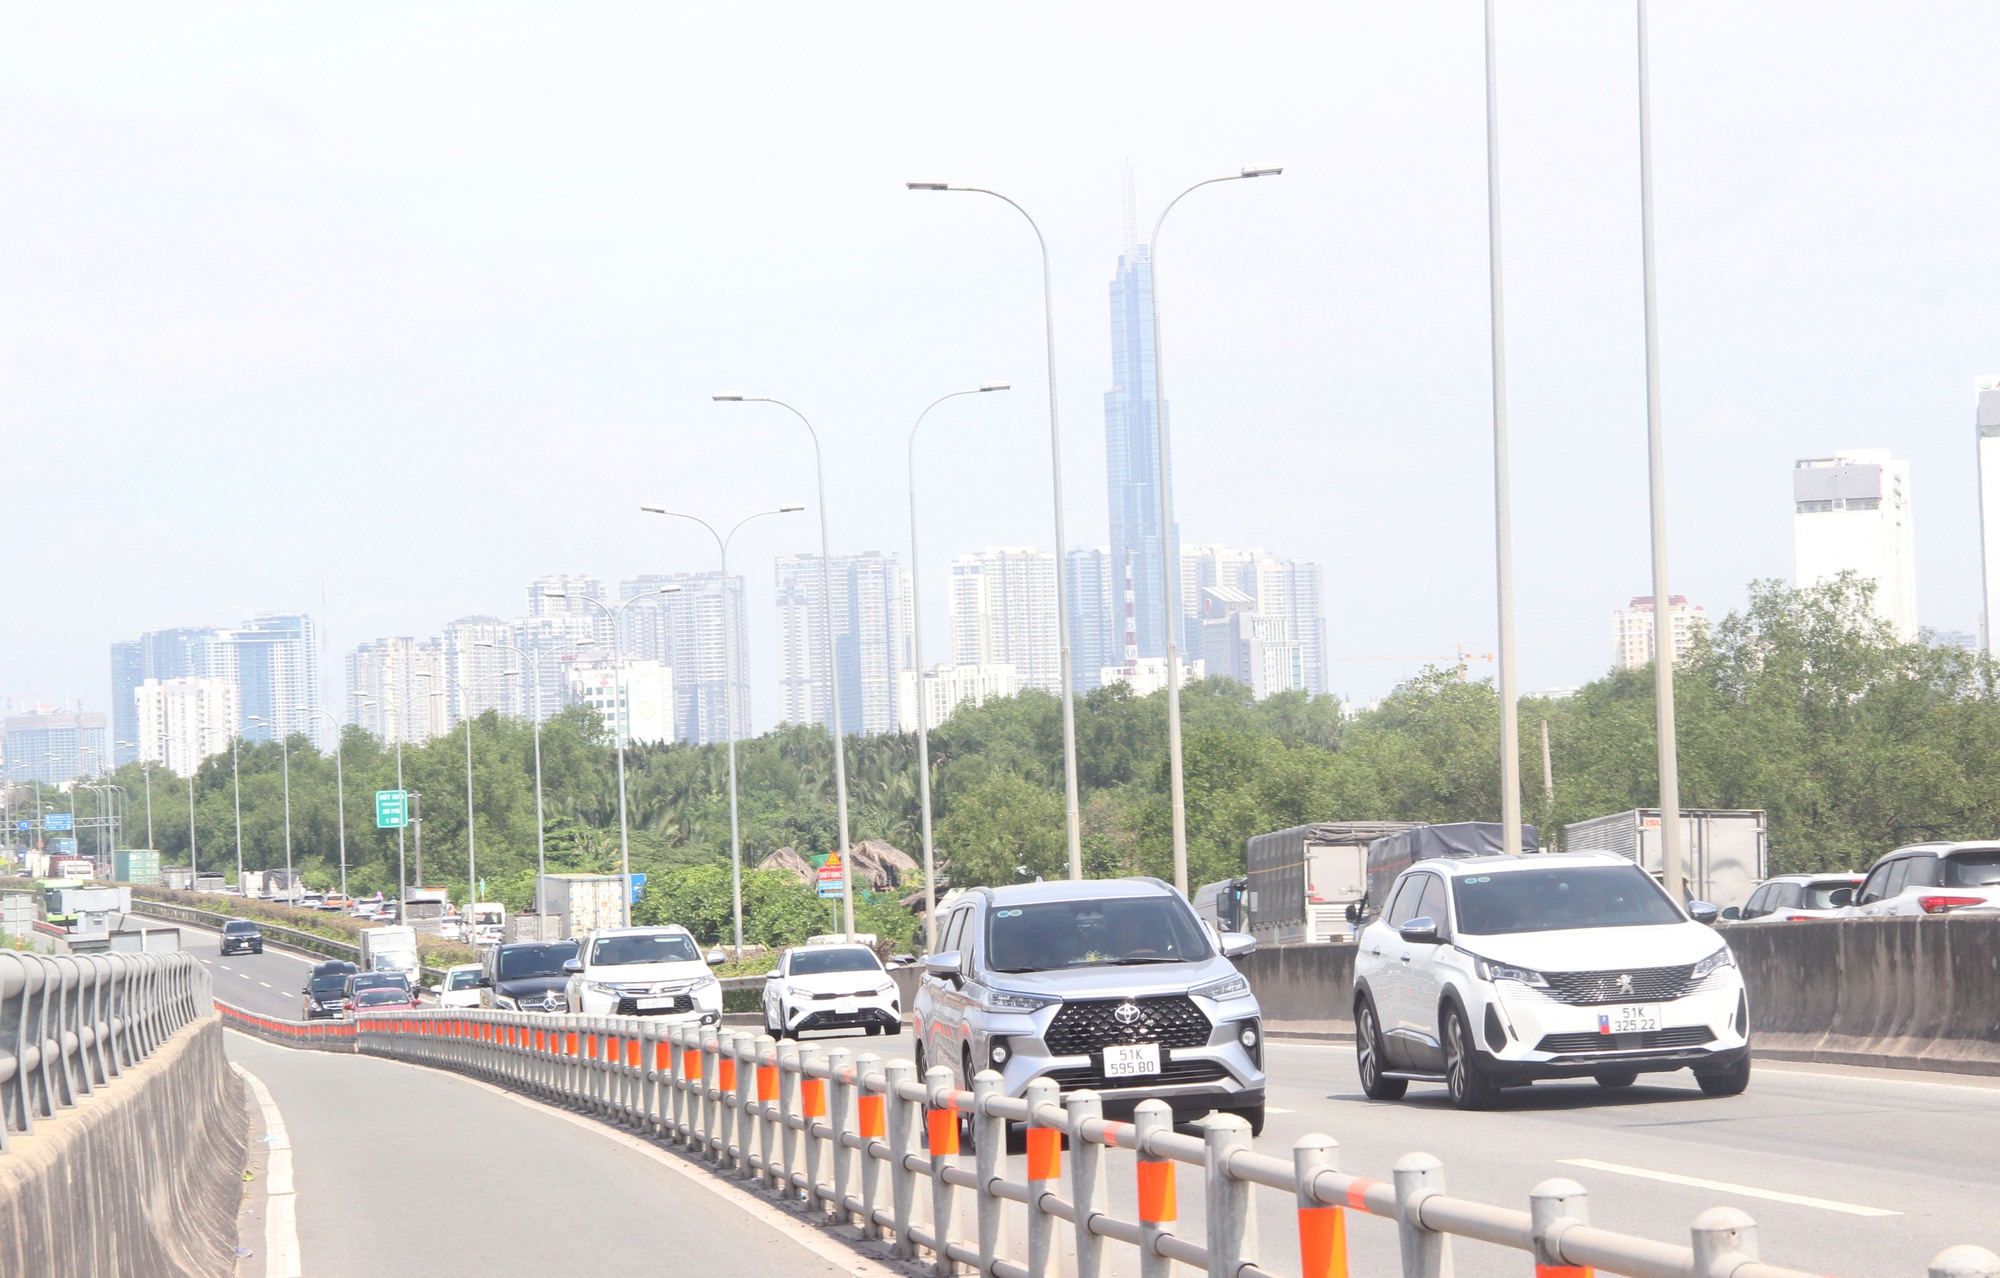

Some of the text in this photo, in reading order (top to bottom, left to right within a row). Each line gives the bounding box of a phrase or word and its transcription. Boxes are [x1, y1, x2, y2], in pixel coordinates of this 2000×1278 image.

[1621, 1006, 1645, 1019] 51K
[1614, 1018, 1656, 1032] 325.22
[1119, 1048, 1143, 1061] 51K
[1110, 1060, 1154, 1075] 595.80
